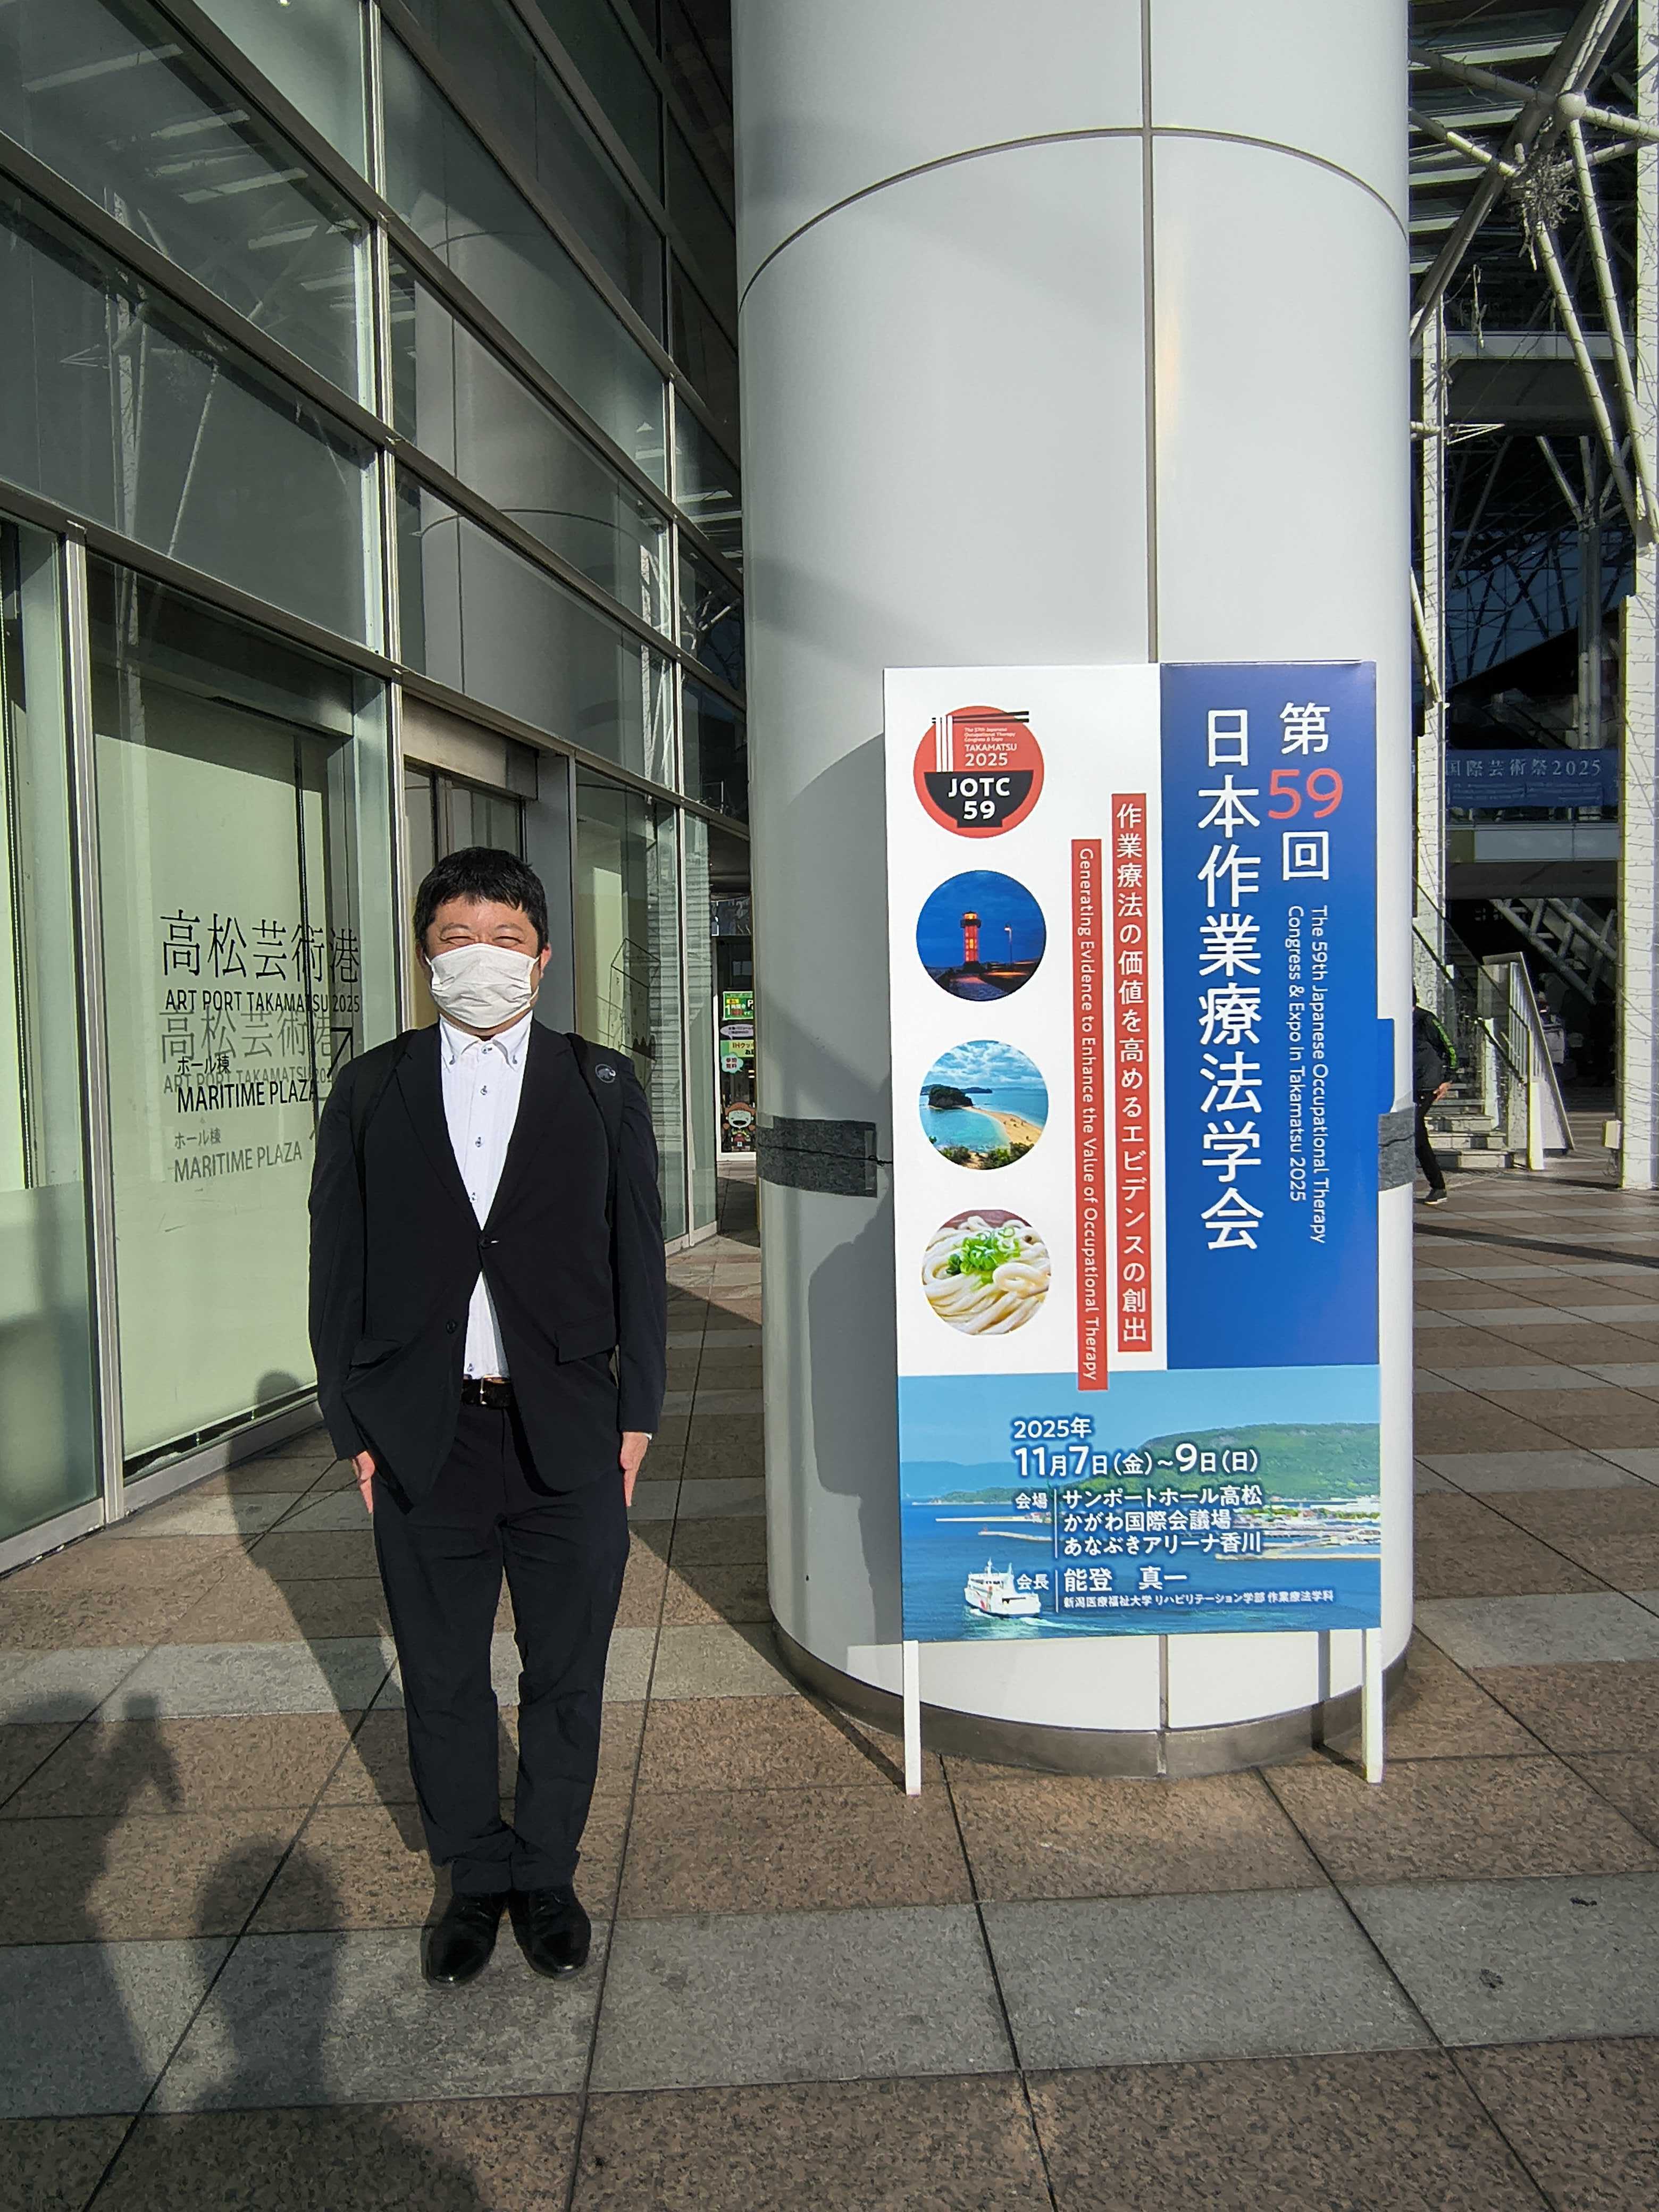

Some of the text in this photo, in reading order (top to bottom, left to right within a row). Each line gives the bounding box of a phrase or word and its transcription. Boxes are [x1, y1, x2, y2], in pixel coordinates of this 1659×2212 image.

[965, 743, 1017, 752] TAKAMATSU
[965, 752, 1008, 767] 2025
[948, 778, 1010, 798] JOTC
[1268, 702, 1343, 881] 第59回
[963, 800, 995, 820] 59
[160, 909, 359, 984] 高松芸術港
[1197, 709, 1264, 1250] 日本作業療法学会
[165, 990, 360, 1013] ART PORT TAKAMASU 2025
[1285, 906, 1306, 1202] Congress & Expo in Takamatsu 2025
[1116, 802, 1147, 1342] 作業療法の価値を高めるエビデンスの創出
[1309, 905, 1330, 1244] The 59th Japanese Occupational Therapy
[178, 1078, 316, 1113] MARITIME PLAZA
[1078, 848, 1100, 1381] Generating Evidence to Enhance the Value of Occupational Therapy
[1013, 1417, 1092, 1438] 2025年
[1015, 1492, 1048, 1510] 会場
[1062, 1484, 1263, 1509] サンポートホール高松
[1063, 1509, 1232, 1532] かがわ国際会議場
[1063, 1531, 1262, 1556] あなぶきアリーナ香川
[1017, 1573, 1050, 1590] 会長
[1063, 1590, 1334, 1608] 新潟医療福祉大学 リハビリテーション学部 作業療法学科
